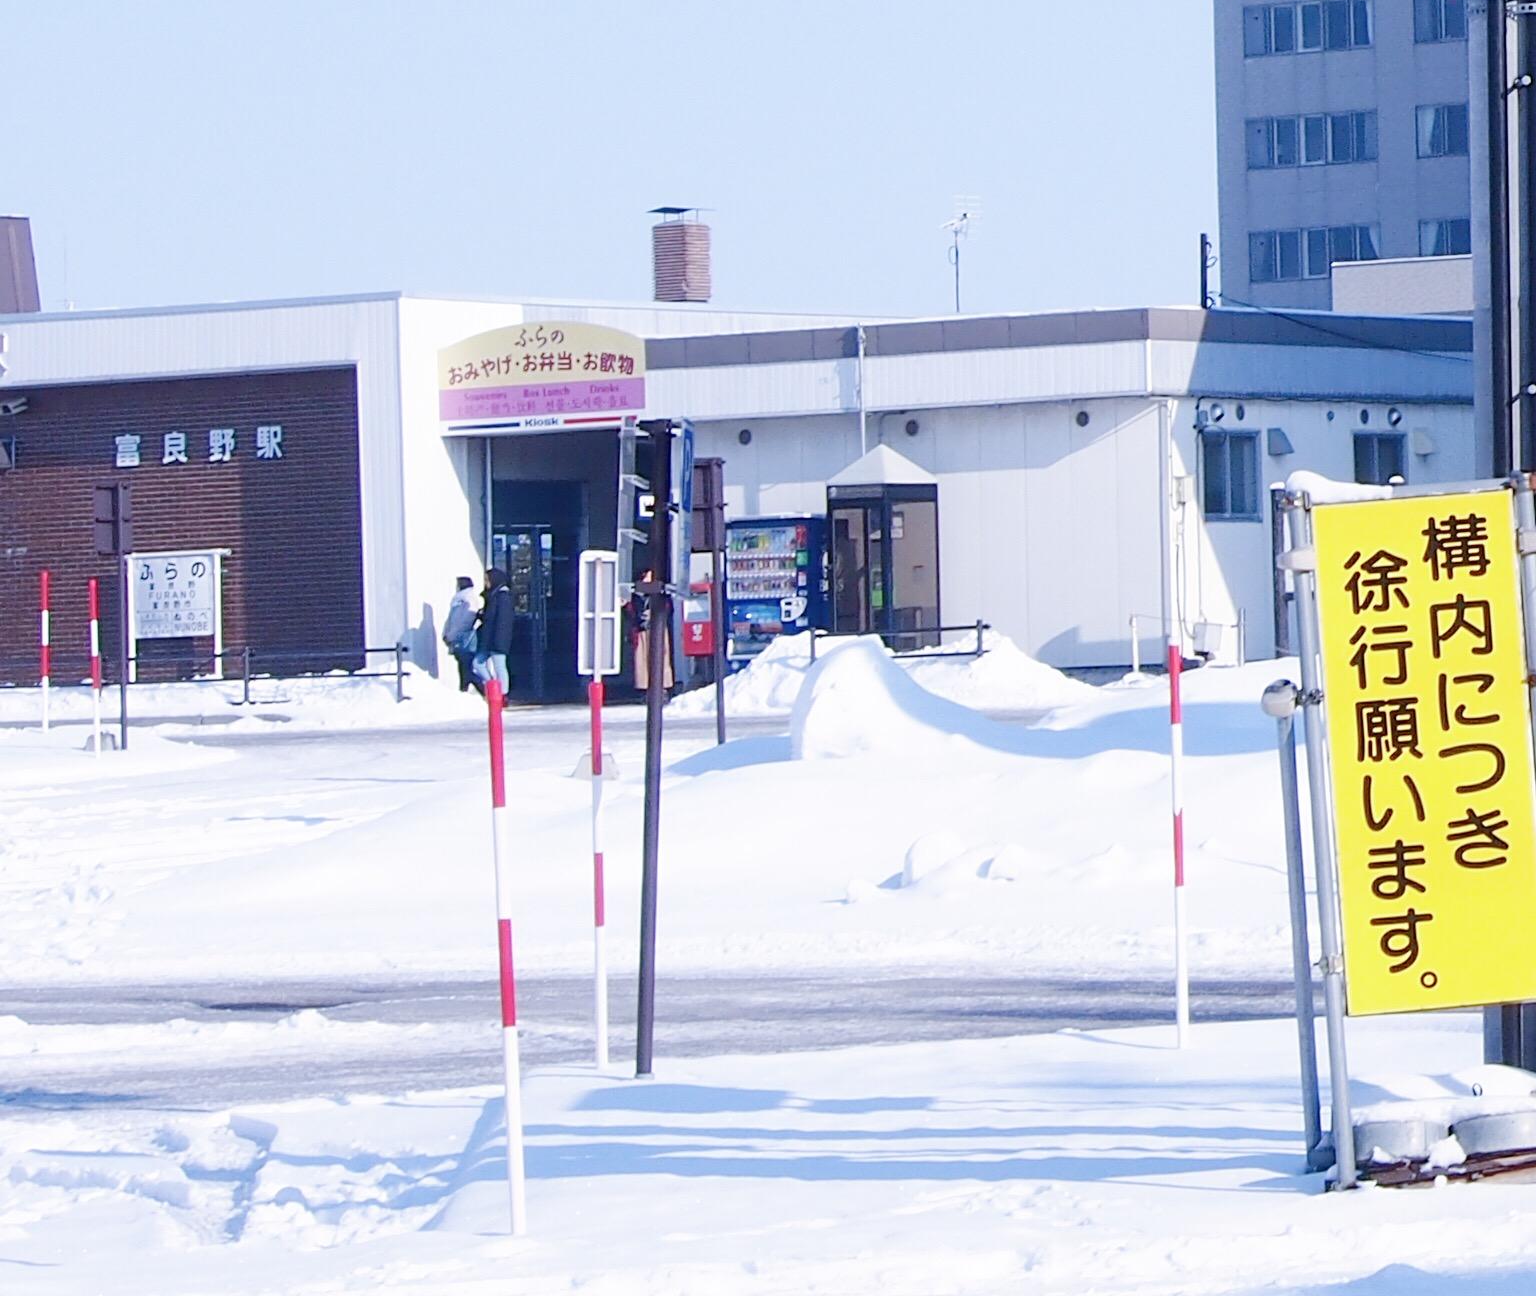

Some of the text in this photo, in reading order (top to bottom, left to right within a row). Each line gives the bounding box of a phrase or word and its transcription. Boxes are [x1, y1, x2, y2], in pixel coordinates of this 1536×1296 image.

[514, 325, 565, 349] ふらの
[542, 384, 570, 397] Lunch
[524, 418, 559, 427] Kiosk
[114, 425, 283, 469] 富良野駅
[140, 561, 206, 581] ふらの
[148, 590, 196, 600] FURANO
[1420, 513, 1509, 871] 構内につき
[1344, 549, 1438, 991] 徐行願います。
